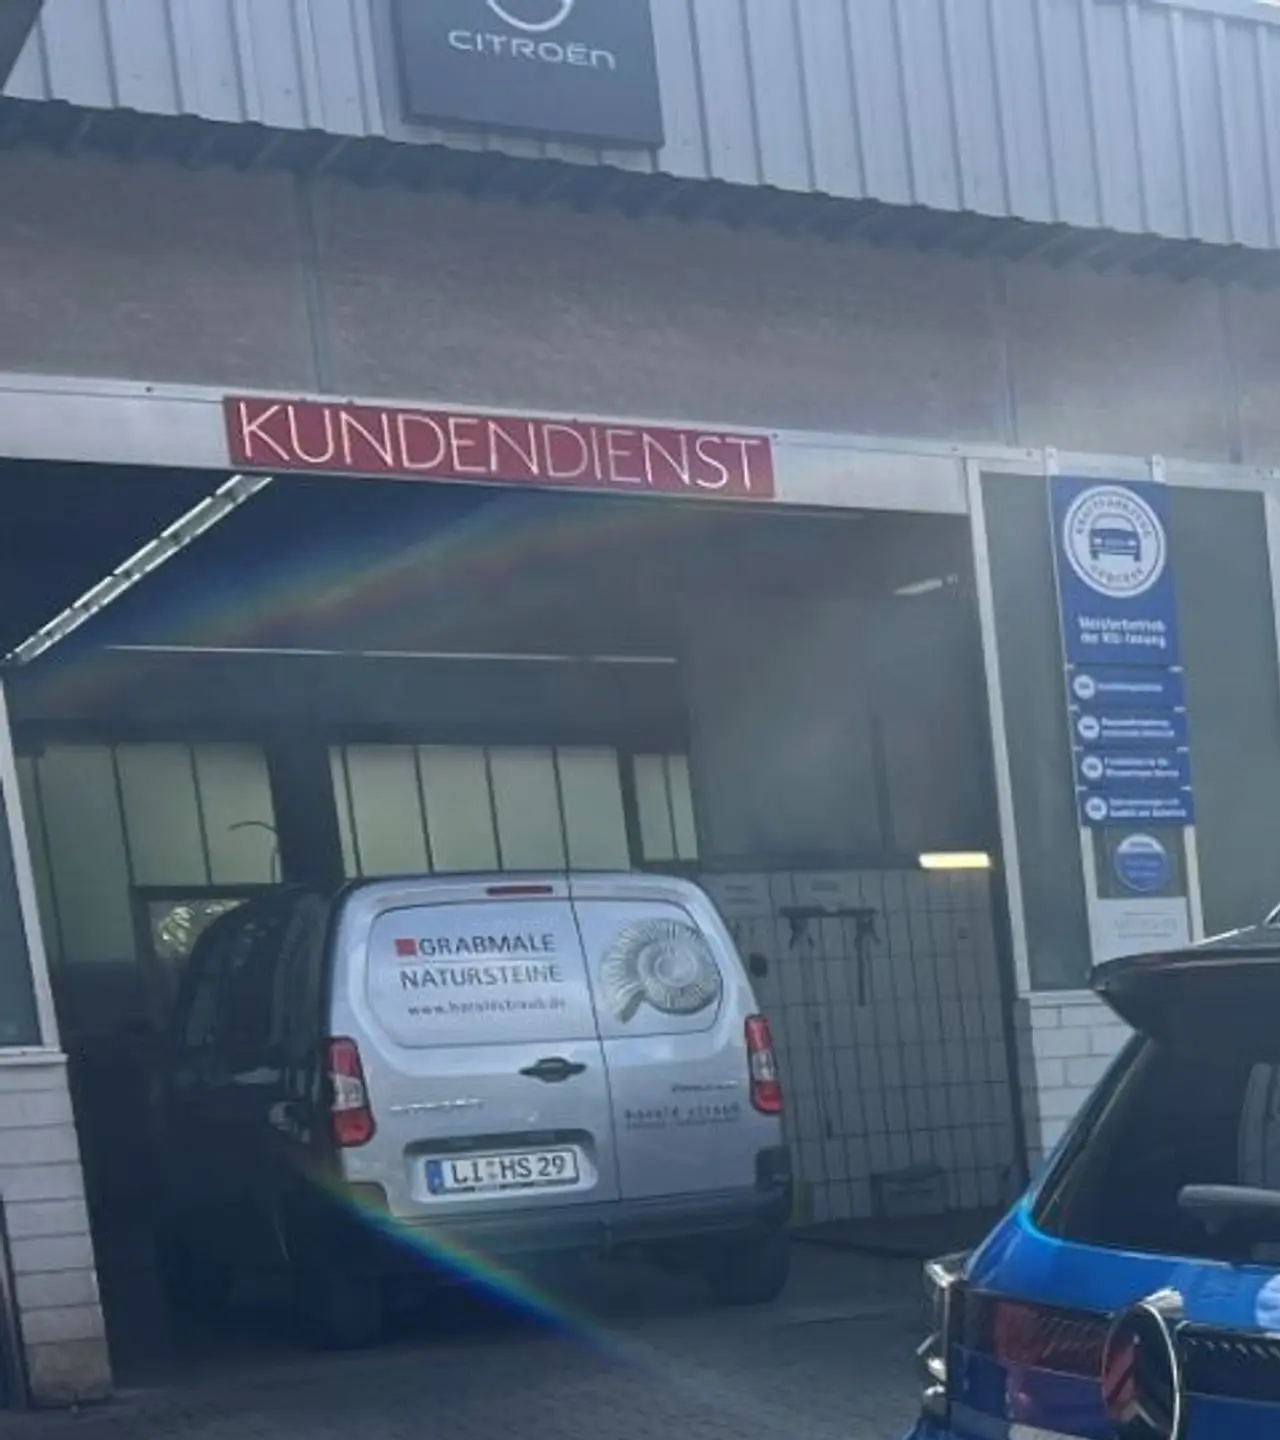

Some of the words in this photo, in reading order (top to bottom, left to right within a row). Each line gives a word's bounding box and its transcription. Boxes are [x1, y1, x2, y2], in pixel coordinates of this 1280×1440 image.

[449, 30, 616, 71] CITROËN
[239, 401, 762, 492] KUNDENDIENST
[418, 932, 556, 957] GRABMALE
[400, 963, 565, 990] NATURSTEINE
[501, 1157, 532, 1180] HS
[537, 1154, 566, 1177] 29
